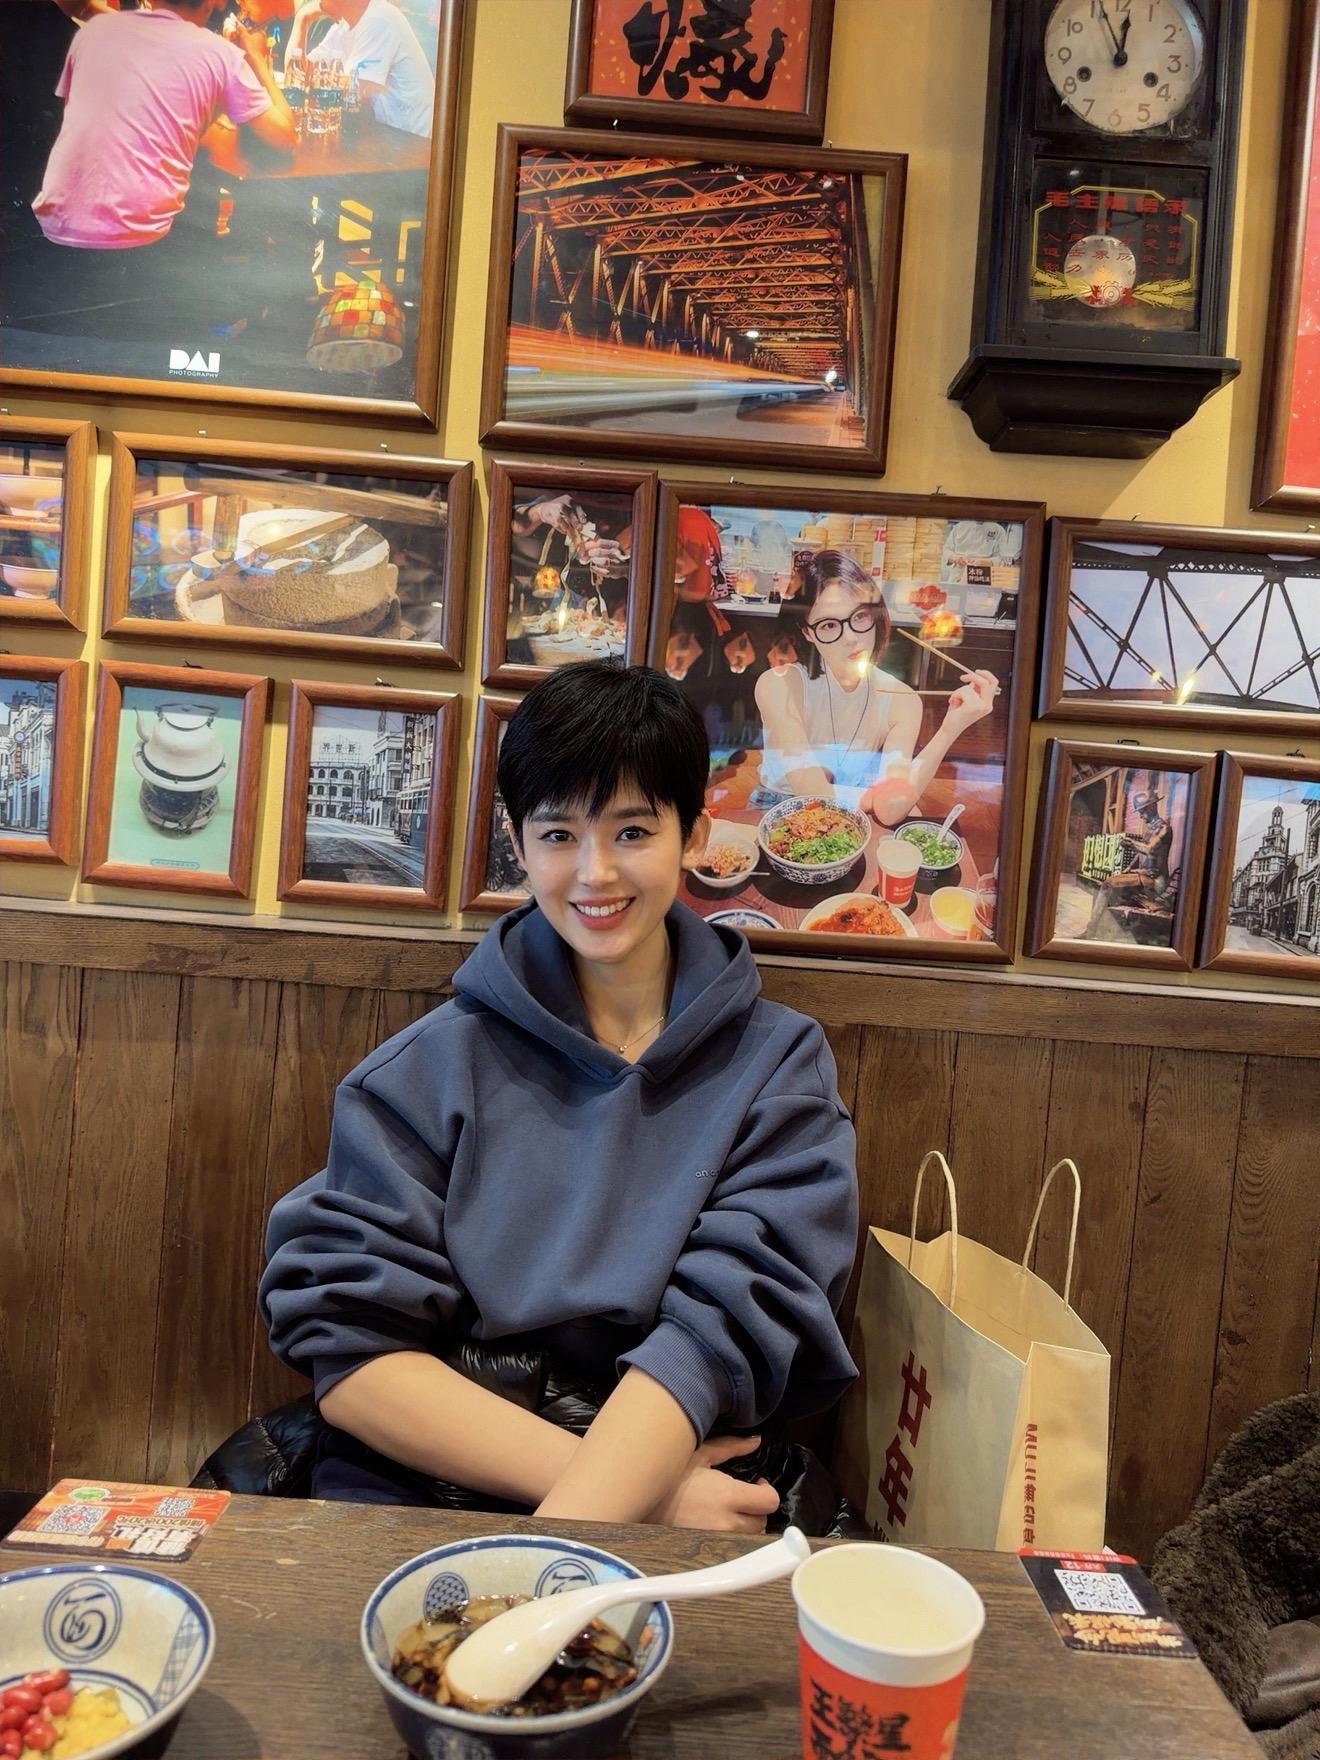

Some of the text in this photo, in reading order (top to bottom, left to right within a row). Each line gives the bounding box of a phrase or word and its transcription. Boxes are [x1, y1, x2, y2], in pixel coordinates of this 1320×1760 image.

[1066, 19, 1084, 37] 10
[1163, 24, 1177, 43] 2
[1057, 47, 1072, 65] 9
[1167, 55, 1182, 73] 3
[1063, 76, 1077, 95] 8
[1156, 83, 1171, 102] 4
[1082, 98, 1096, 117] 7
[1137, 103, 1151, 123] 5
[1107, 109, 1122, 127] 6
[169, 349, 221, 373] DAI
[168, 369, 219, 378] PHOTOGRAPHY
